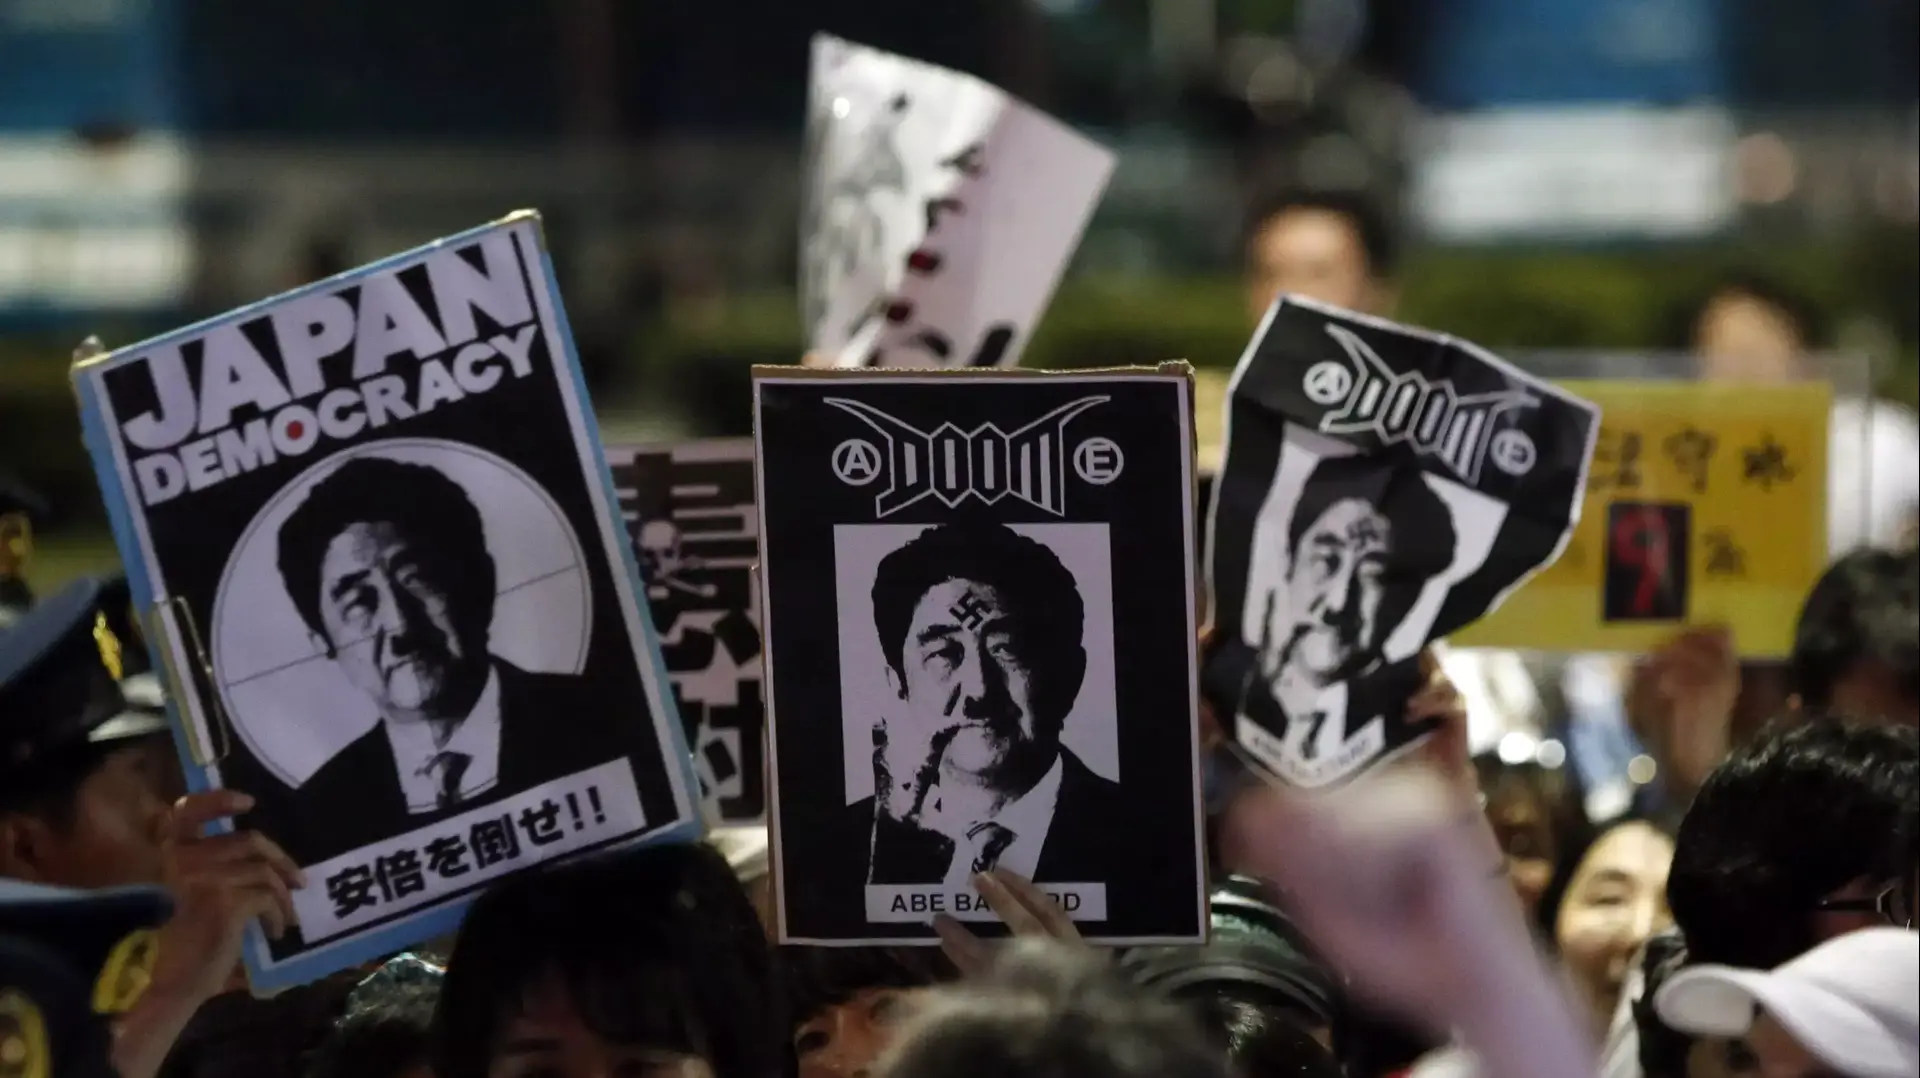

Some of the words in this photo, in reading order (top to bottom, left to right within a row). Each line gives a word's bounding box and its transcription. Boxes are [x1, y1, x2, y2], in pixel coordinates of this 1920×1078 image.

[123, 230, 535, 449] JAPAN
[135, 325, 538, 506] DEMOCRACY
[890, 892, 946, 913] ABE
